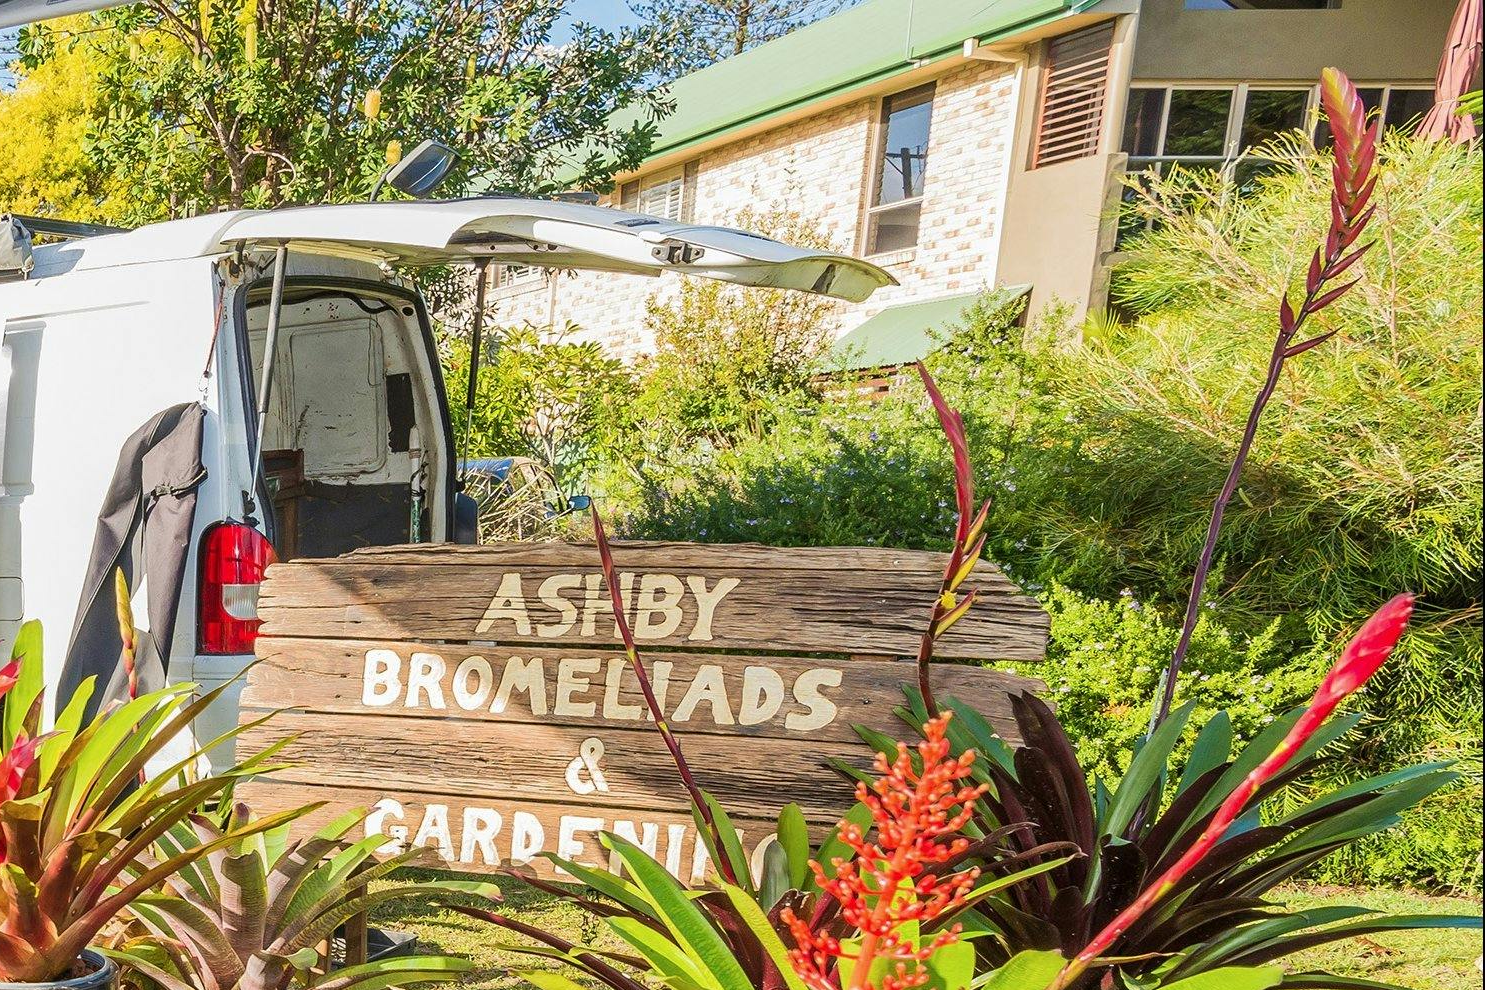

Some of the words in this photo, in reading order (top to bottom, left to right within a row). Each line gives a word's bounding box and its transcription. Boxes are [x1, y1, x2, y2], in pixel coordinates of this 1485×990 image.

[474, 572, 742, 641] ASHBY
[361, 649, 843, 730] BROMELIADS
[564, 736, 609, 795] &
